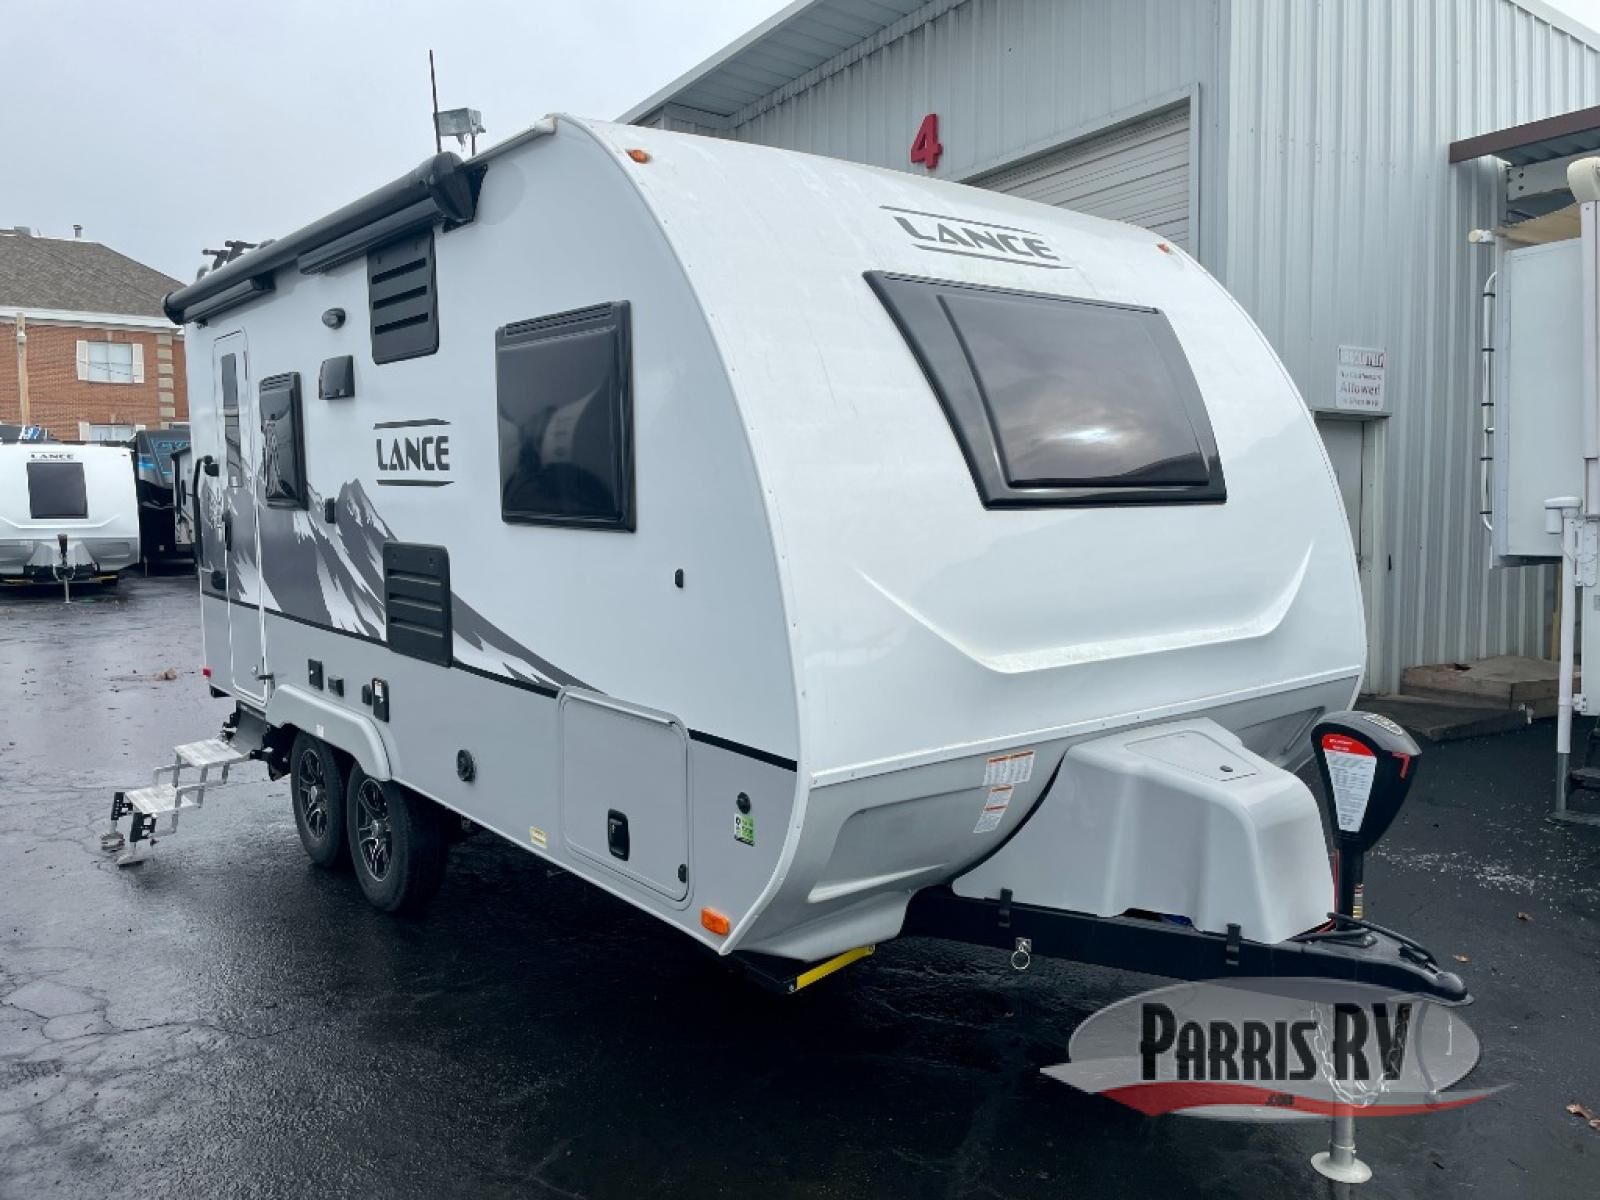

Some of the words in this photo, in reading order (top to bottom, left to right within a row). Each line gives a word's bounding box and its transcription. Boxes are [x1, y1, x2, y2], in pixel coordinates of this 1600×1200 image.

[910, 113, 943, 169] 4
[893, 216, 1060, 261] LANCE
[376, 435, 450, 471] LANCE
